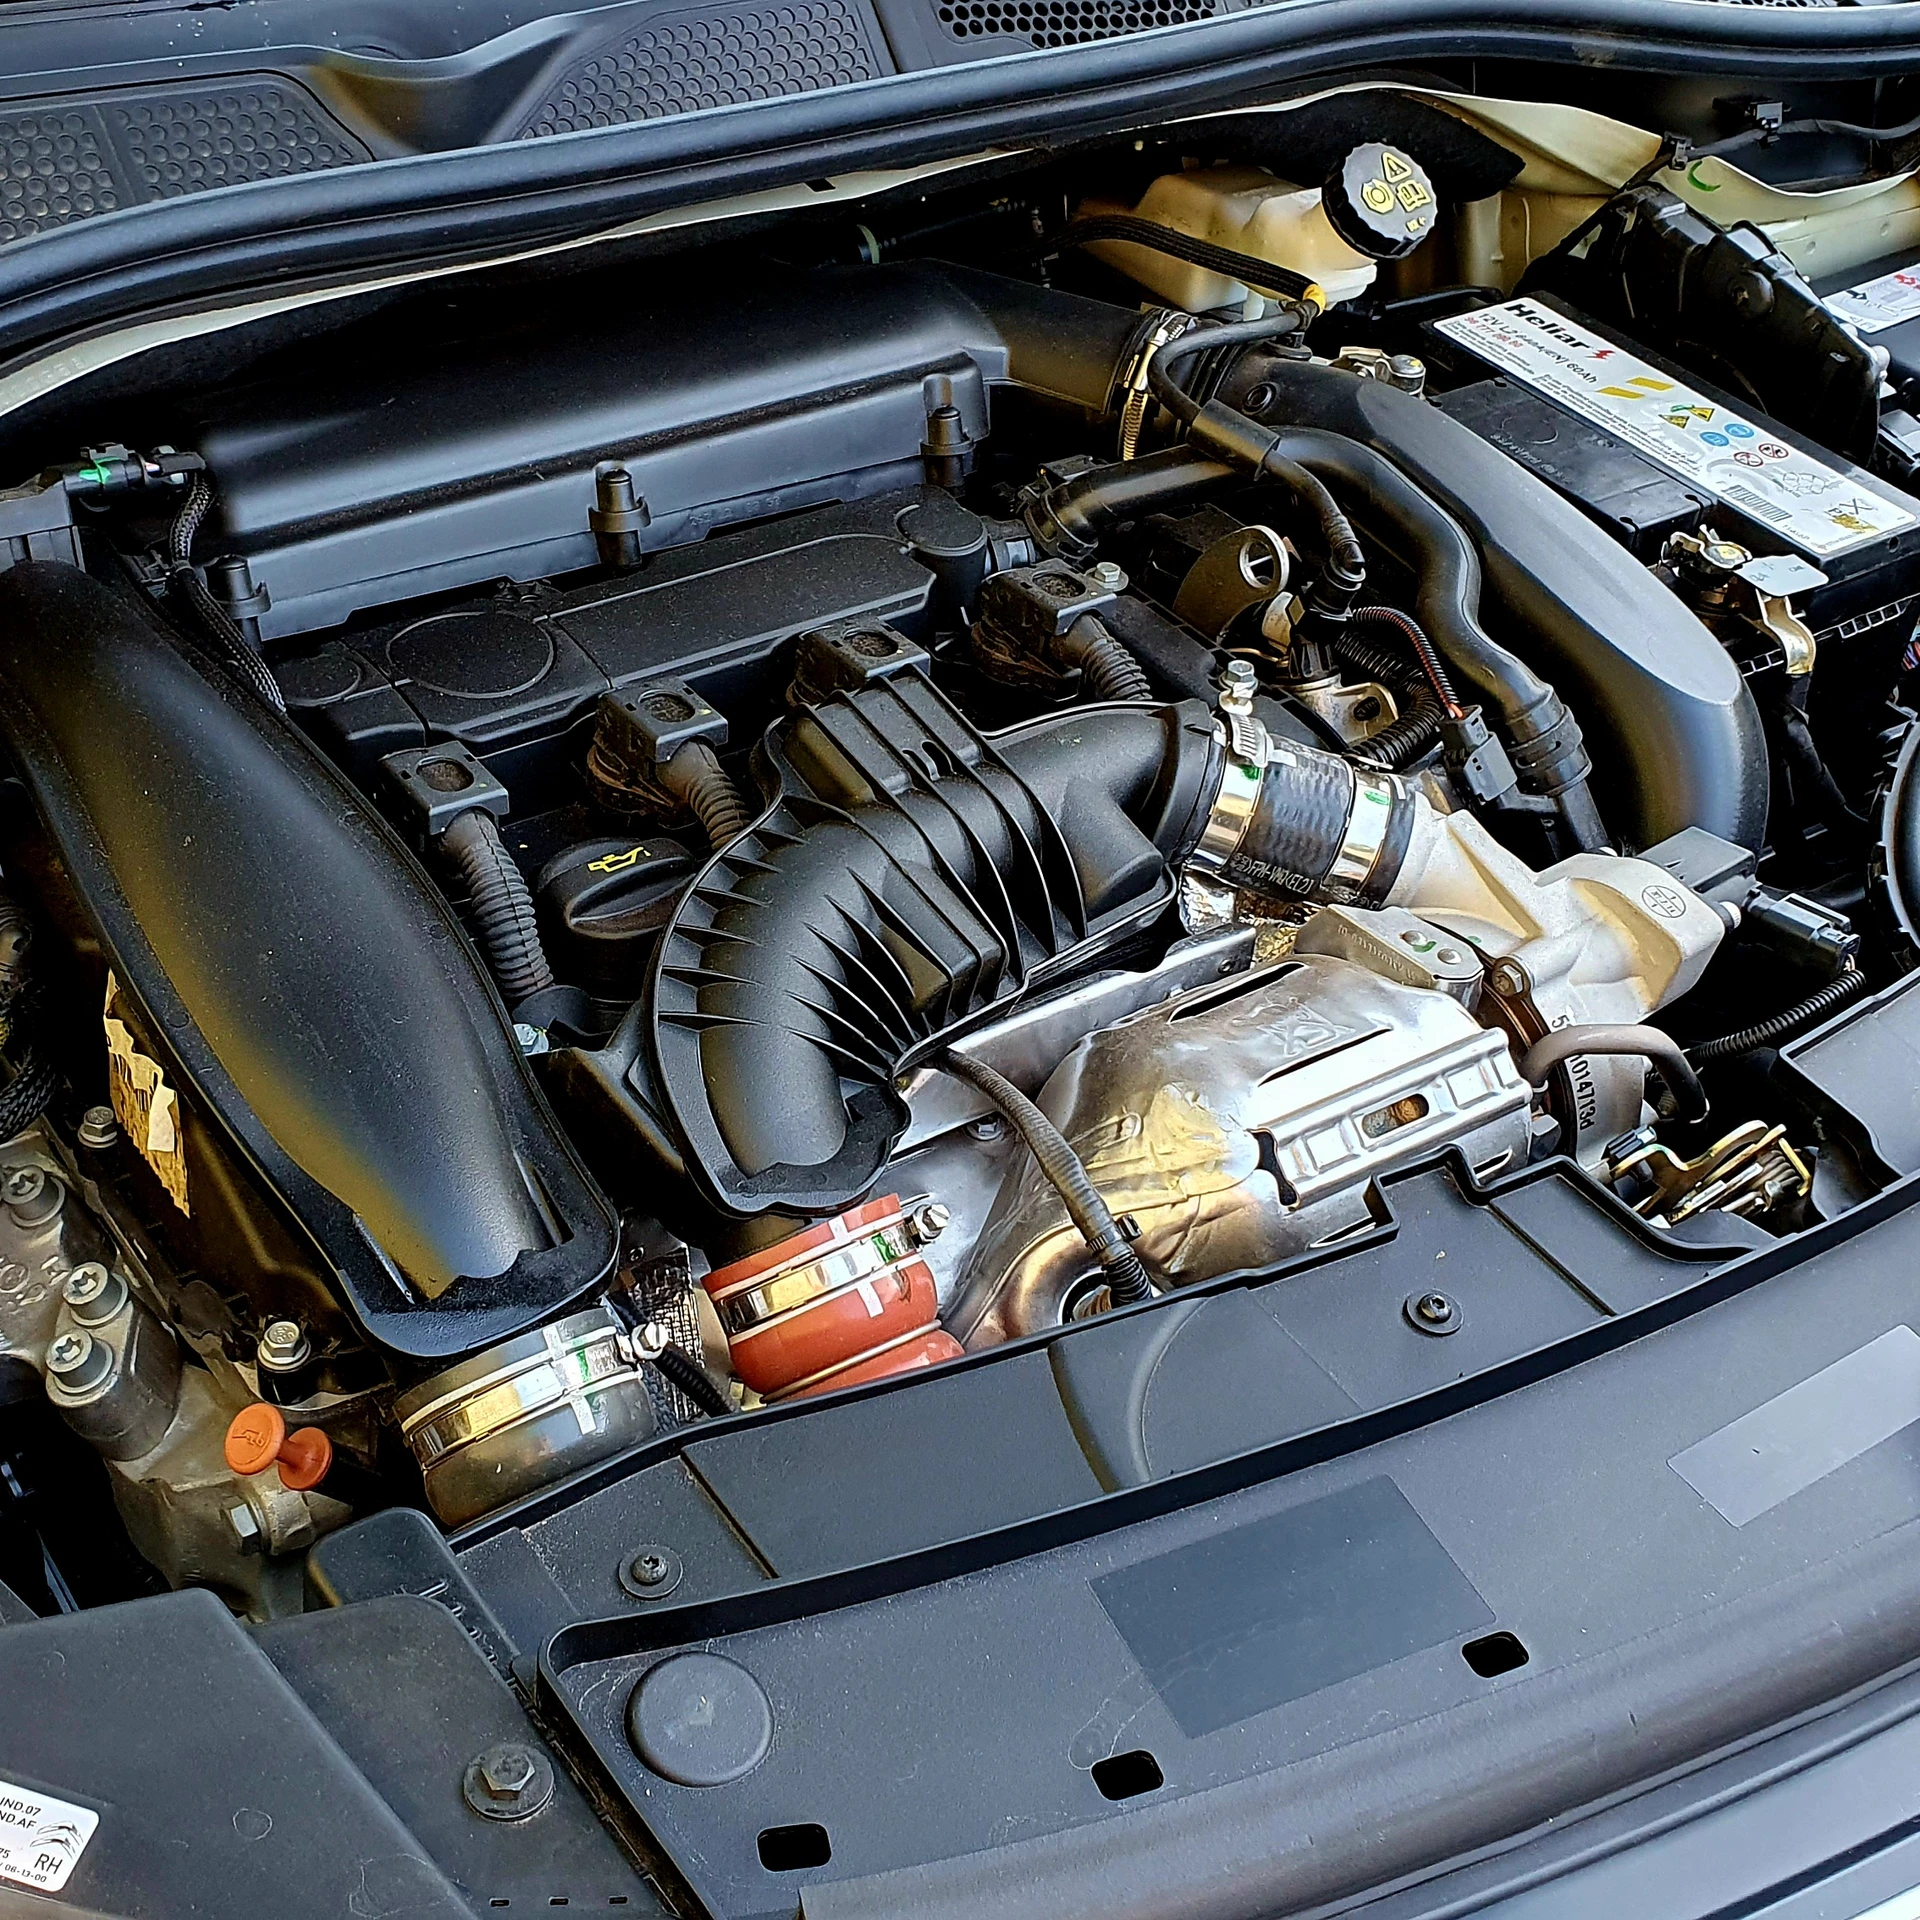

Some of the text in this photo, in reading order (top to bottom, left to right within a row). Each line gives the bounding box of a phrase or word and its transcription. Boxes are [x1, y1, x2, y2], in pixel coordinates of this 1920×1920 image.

[1504, 303, 1591, 348] Heliar
[1478, 313, 1504, 326] 12V
[1566, 362, 1598, 384] 60Ah
[34, 1853, 63, 1875] RH
